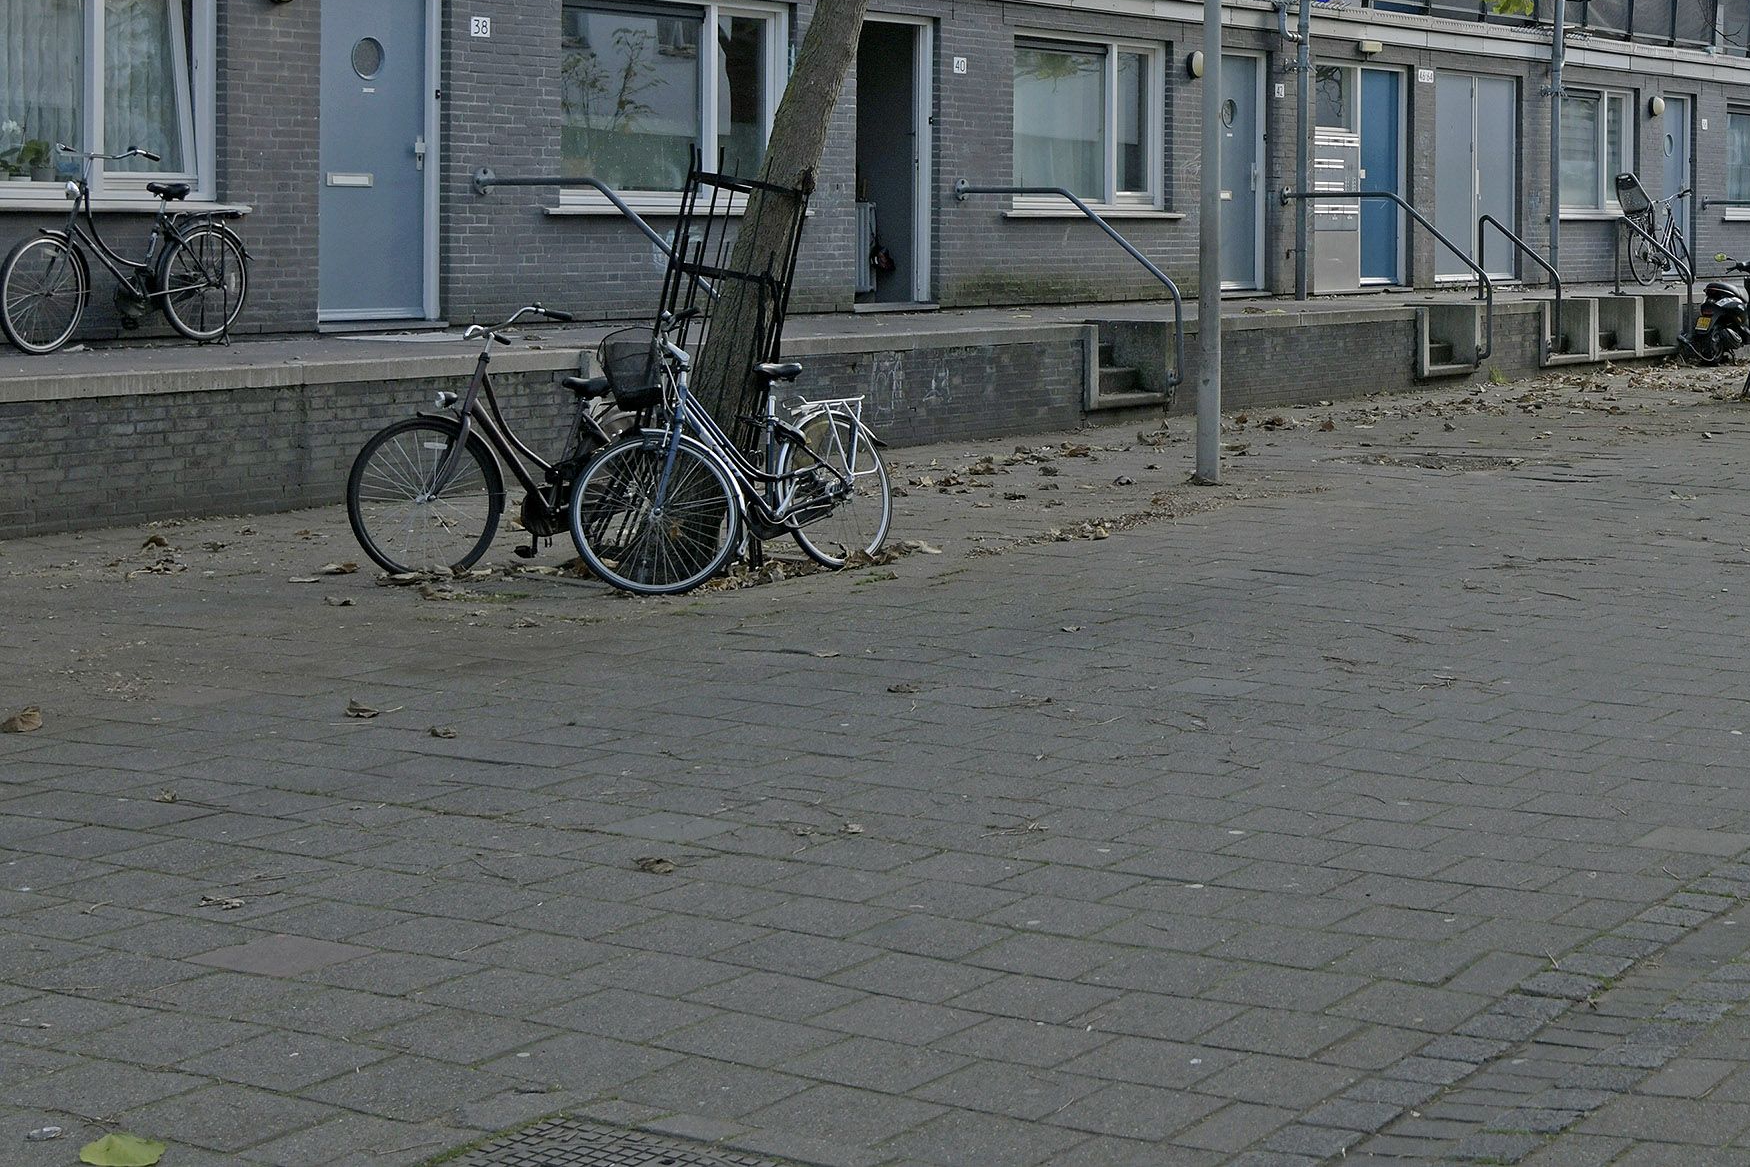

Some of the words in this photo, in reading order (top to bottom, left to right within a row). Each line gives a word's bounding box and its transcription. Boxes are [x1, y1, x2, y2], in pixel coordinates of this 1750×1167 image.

[473, 19, 488, 35] 38
[955, 59, 966, 72] 40
[1276, 86, 1283, 97] 42
